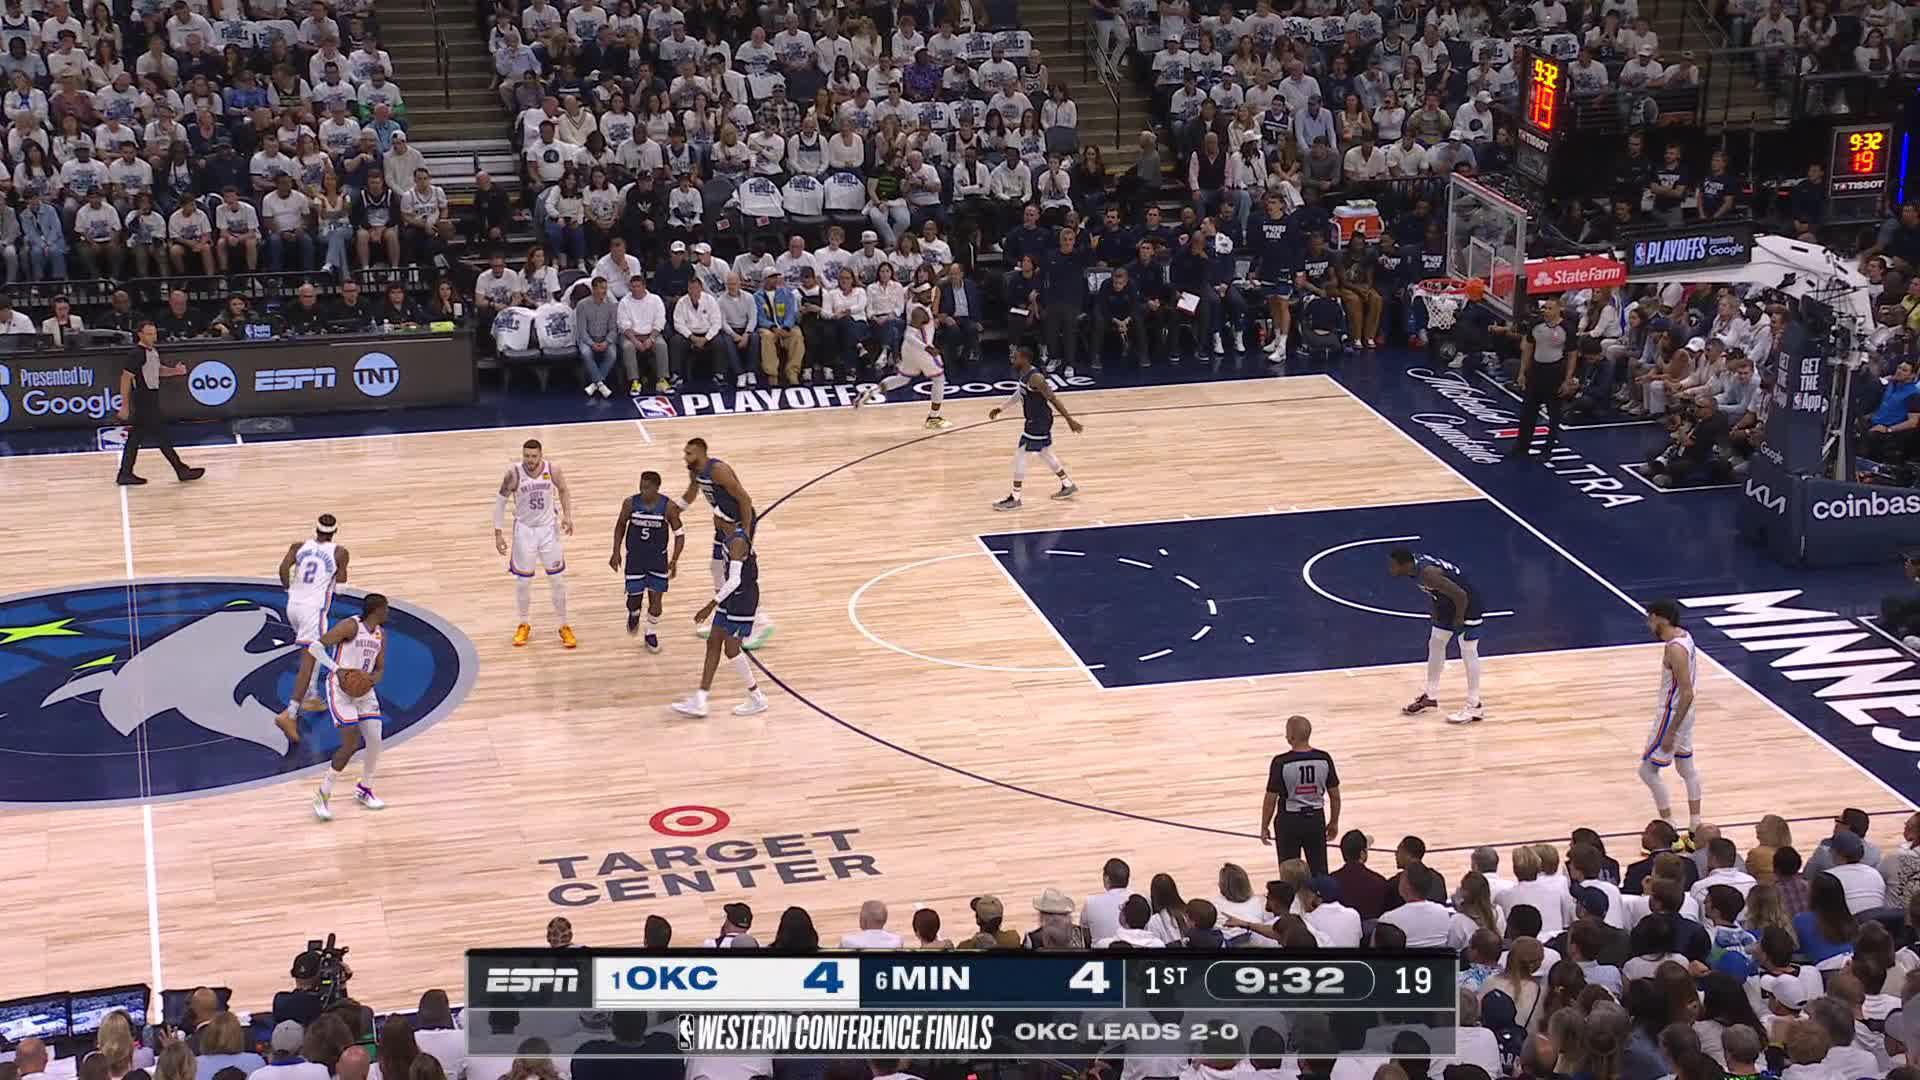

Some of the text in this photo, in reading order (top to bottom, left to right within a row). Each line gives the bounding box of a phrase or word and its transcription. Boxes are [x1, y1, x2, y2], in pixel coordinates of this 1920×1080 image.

[1534, 83, 1554, 130] 19
[1849, 131, 1883, 151] 9:32
[1853, 150, 1875, 172] 19
[1847, 180, 1885, 190] TISSOT
[1646, 236, 1744, 265] PLAYOFFS Google
[353, 367, 399, 385] TNT
[1801, 357, 1821, 374] GET
[20, 366, 95, 388] Presented by
[191, 374, 233, 391] abc
[255, 367, 337, 392] ESPN
[912, 373, 1097, 396] Goole
[1800, 374, 1820, 391] THE
[22, 387, 123, 419] Google
[682, 383, 886, 416] PLAYOFFS
[1802, 392, 1821, 412] App
[529, 498, 544, 510] 55
[1812, 491, 1920, 520] coinbas
[640, 527, 650, 541] 5
[303, 561, 318, 584] 2
[1299, 765, 1316, 785] 10
[538, 828, 860, 880] TARGET
[547, 854, 884, 907] CENTER
